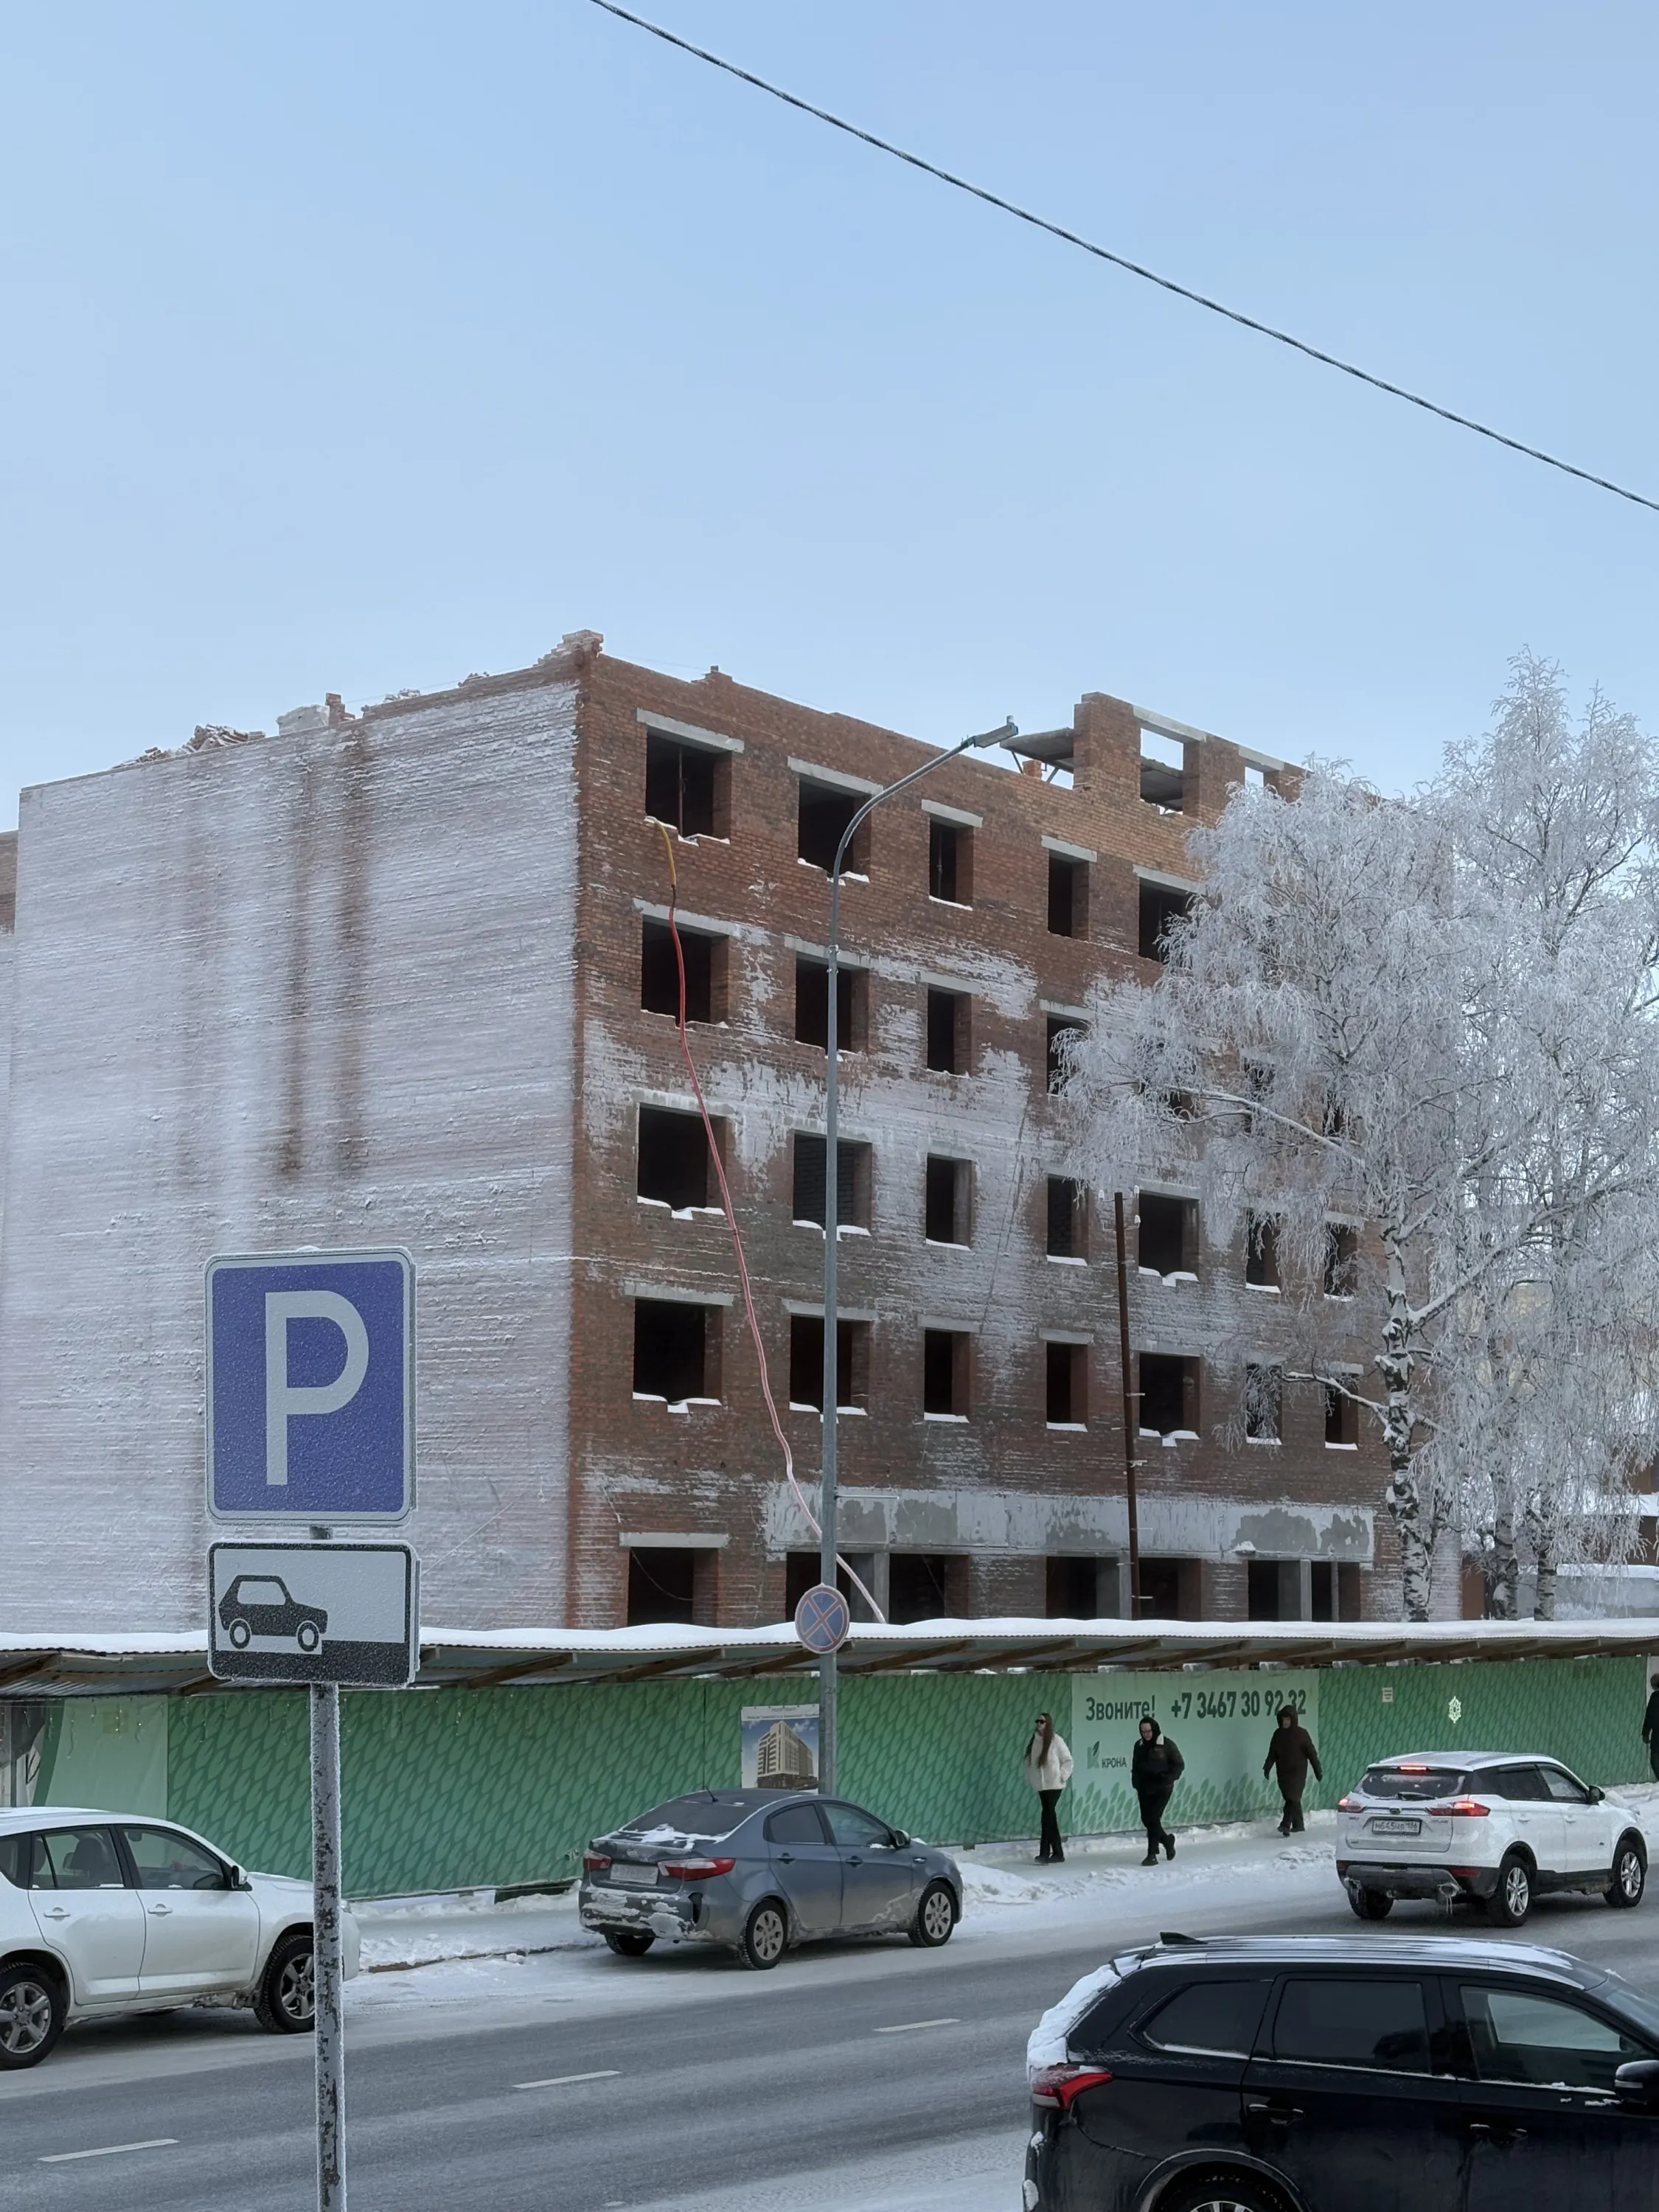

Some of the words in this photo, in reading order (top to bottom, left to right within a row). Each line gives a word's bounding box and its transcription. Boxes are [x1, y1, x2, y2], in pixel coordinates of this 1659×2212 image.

[265, 1290, 369, 1486] P
[1085, 1695, 1155, 1721] Звоните!
[1171, 1692, 1192, 1719] +7
[1197, 1691, 1237, 1719] 3467
[1241, 1690, 1260, 1717] 30
[1265, 1689, 1283, 1717] 92
[1288, 1688, 1307, 1715] 32
[1102, 1757, 1127, 1769] КРОНА
